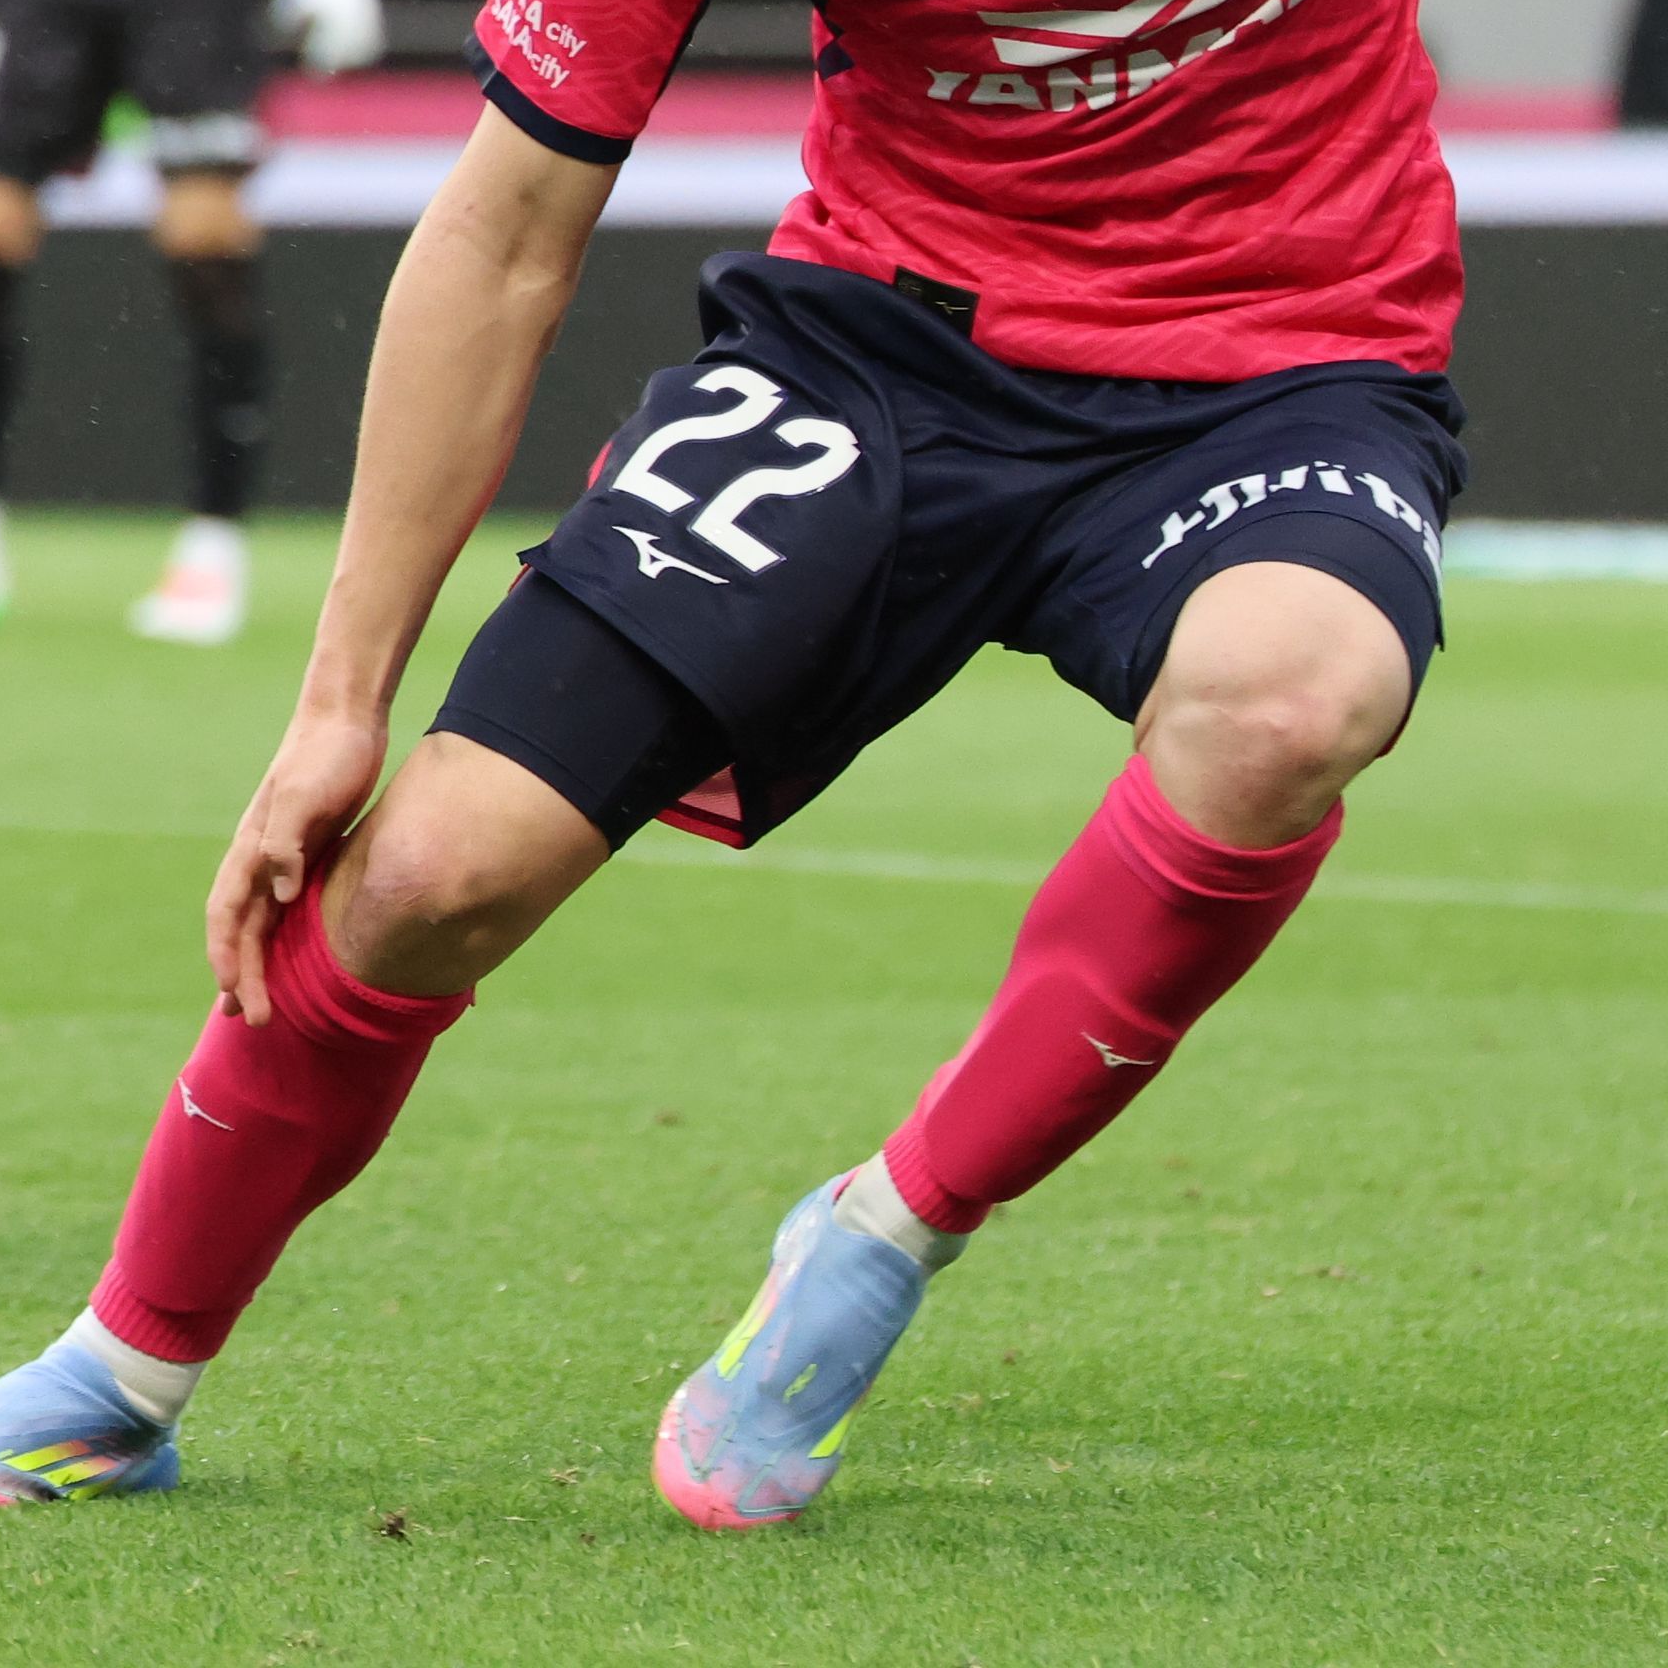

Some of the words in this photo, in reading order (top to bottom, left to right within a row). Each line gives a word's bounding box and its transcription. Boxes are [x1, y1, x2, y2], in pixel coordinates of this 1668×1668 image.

[545, 22, 587, 58] city
[531, 53, 570, 89] city
[611, 365, 862, 573] 22
